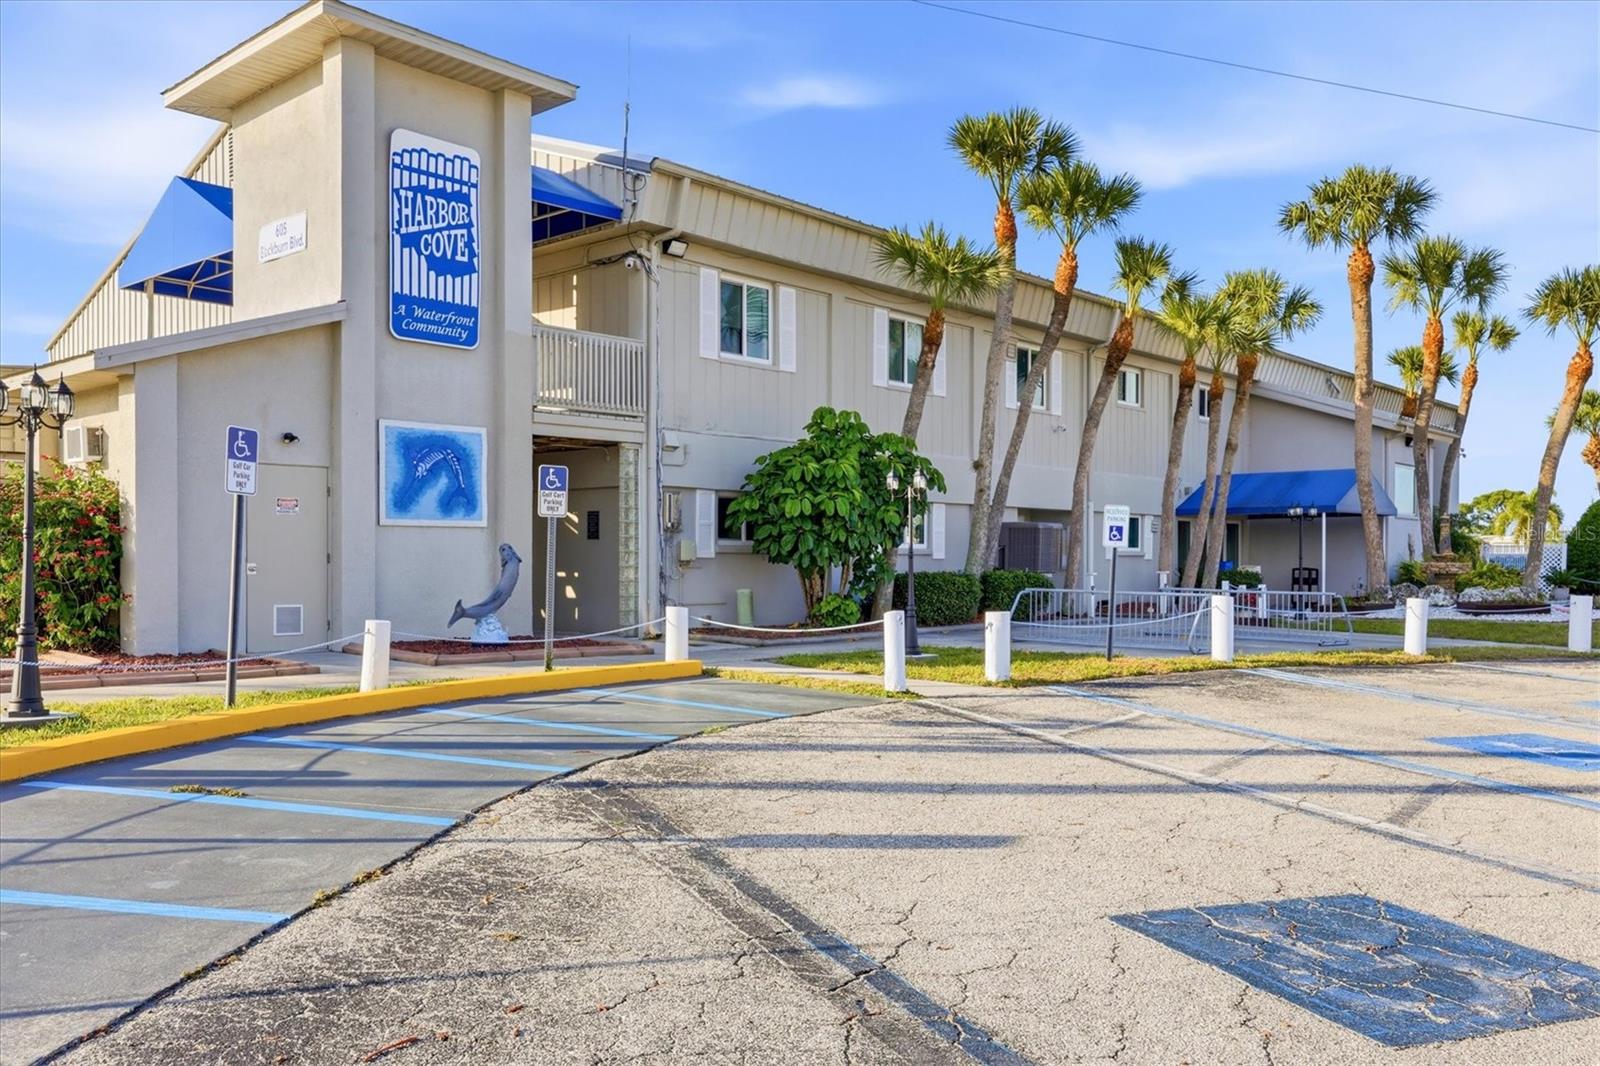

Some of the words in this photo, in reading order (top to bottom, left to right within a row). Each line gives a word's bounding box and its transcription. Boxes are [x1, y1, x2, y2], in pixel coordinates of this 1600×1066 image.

[399, 189, 469, 234] HARBOR
[274, 221, 287, 238] 605
[420, 228, 469, 262] COVE
[393, 304, 406, 316] A
[411, 305, 475, 327] Waterfront
[401, 318, 469, 342] Community
[232, 461, 243, 470] Golf
[233, 470, 251, 482] Parking
[543, 498, 563, 507] Parking
[554, 491, 565, 499] Cart
